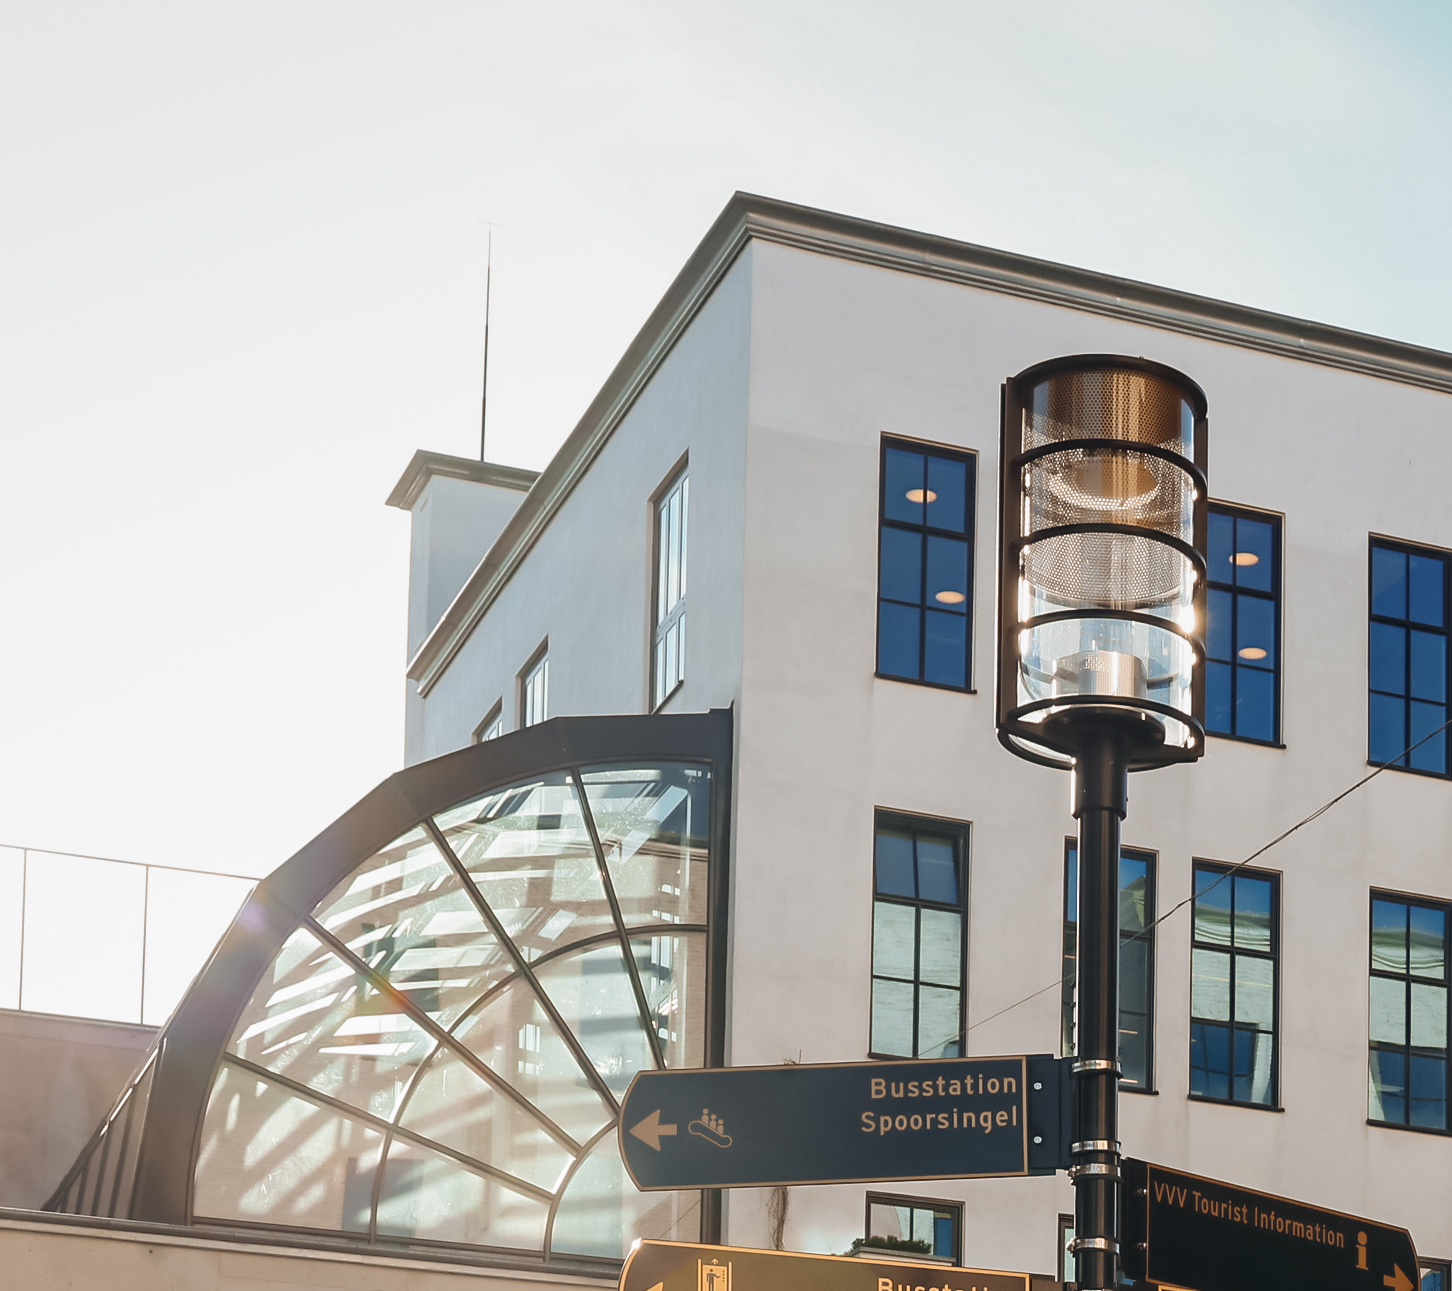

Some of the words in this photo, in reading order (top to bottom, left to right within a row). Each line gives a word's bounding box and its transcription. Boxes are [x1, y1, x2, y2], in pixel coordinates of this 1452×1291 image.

[870, 1073, 1017, 1099] Busstation
[860, 1105, 1017, 1136] Spoorsingel
[1153, 1180, 1188, 1209] VVV
[1192, 1190, 1248, 1224] Tourist
[1253, 1206, 1345, 1248] Information
